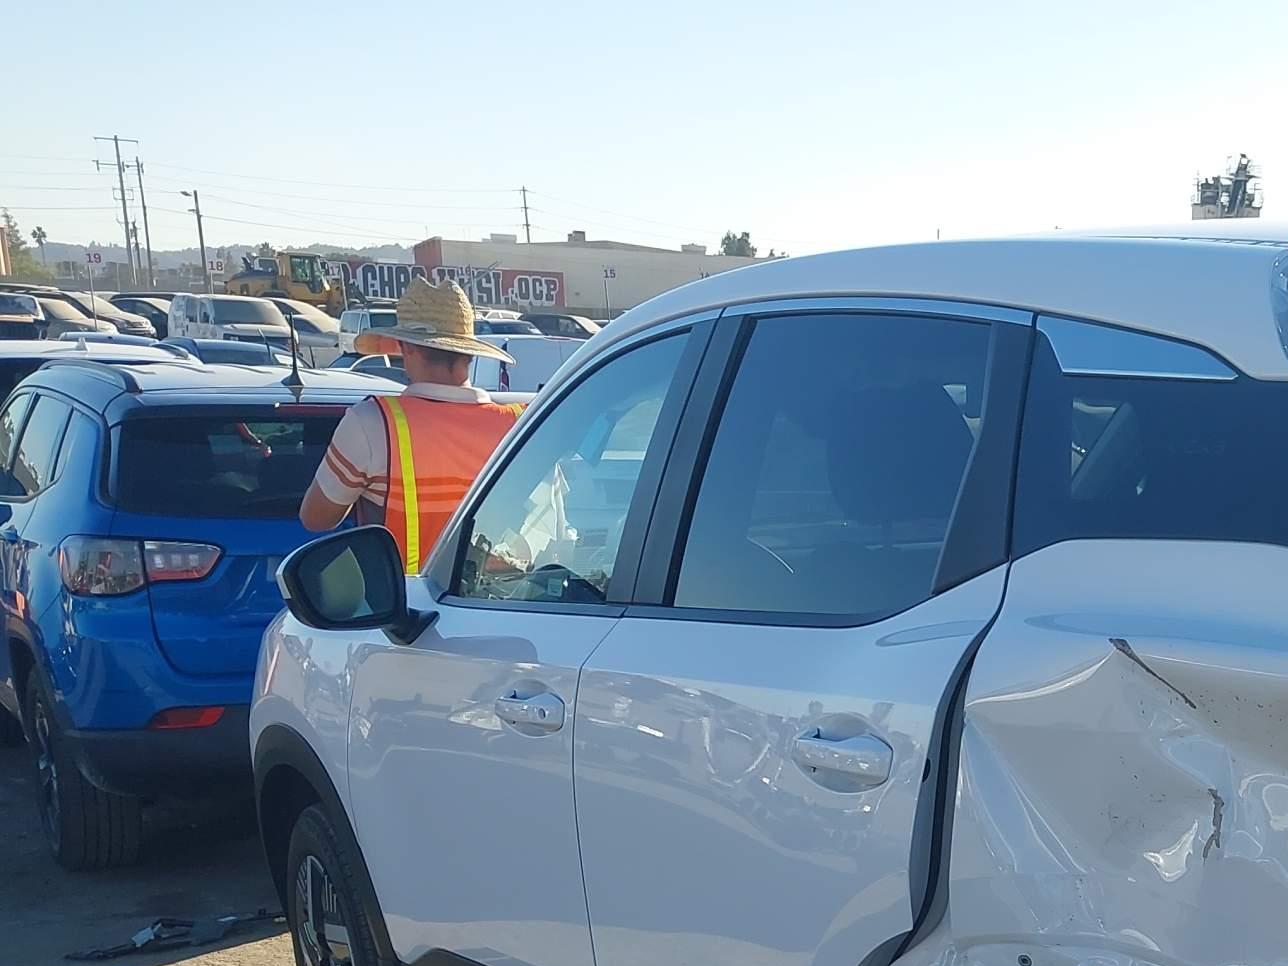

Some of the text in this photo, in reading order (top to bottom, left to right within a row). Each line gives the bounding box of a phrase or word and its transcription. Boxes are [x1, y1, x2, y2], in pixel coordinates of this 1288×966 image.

[86, 252, 102, 264] 19
[208, 260, 224, 272] 18
[603, 268, 616, 279] 15
